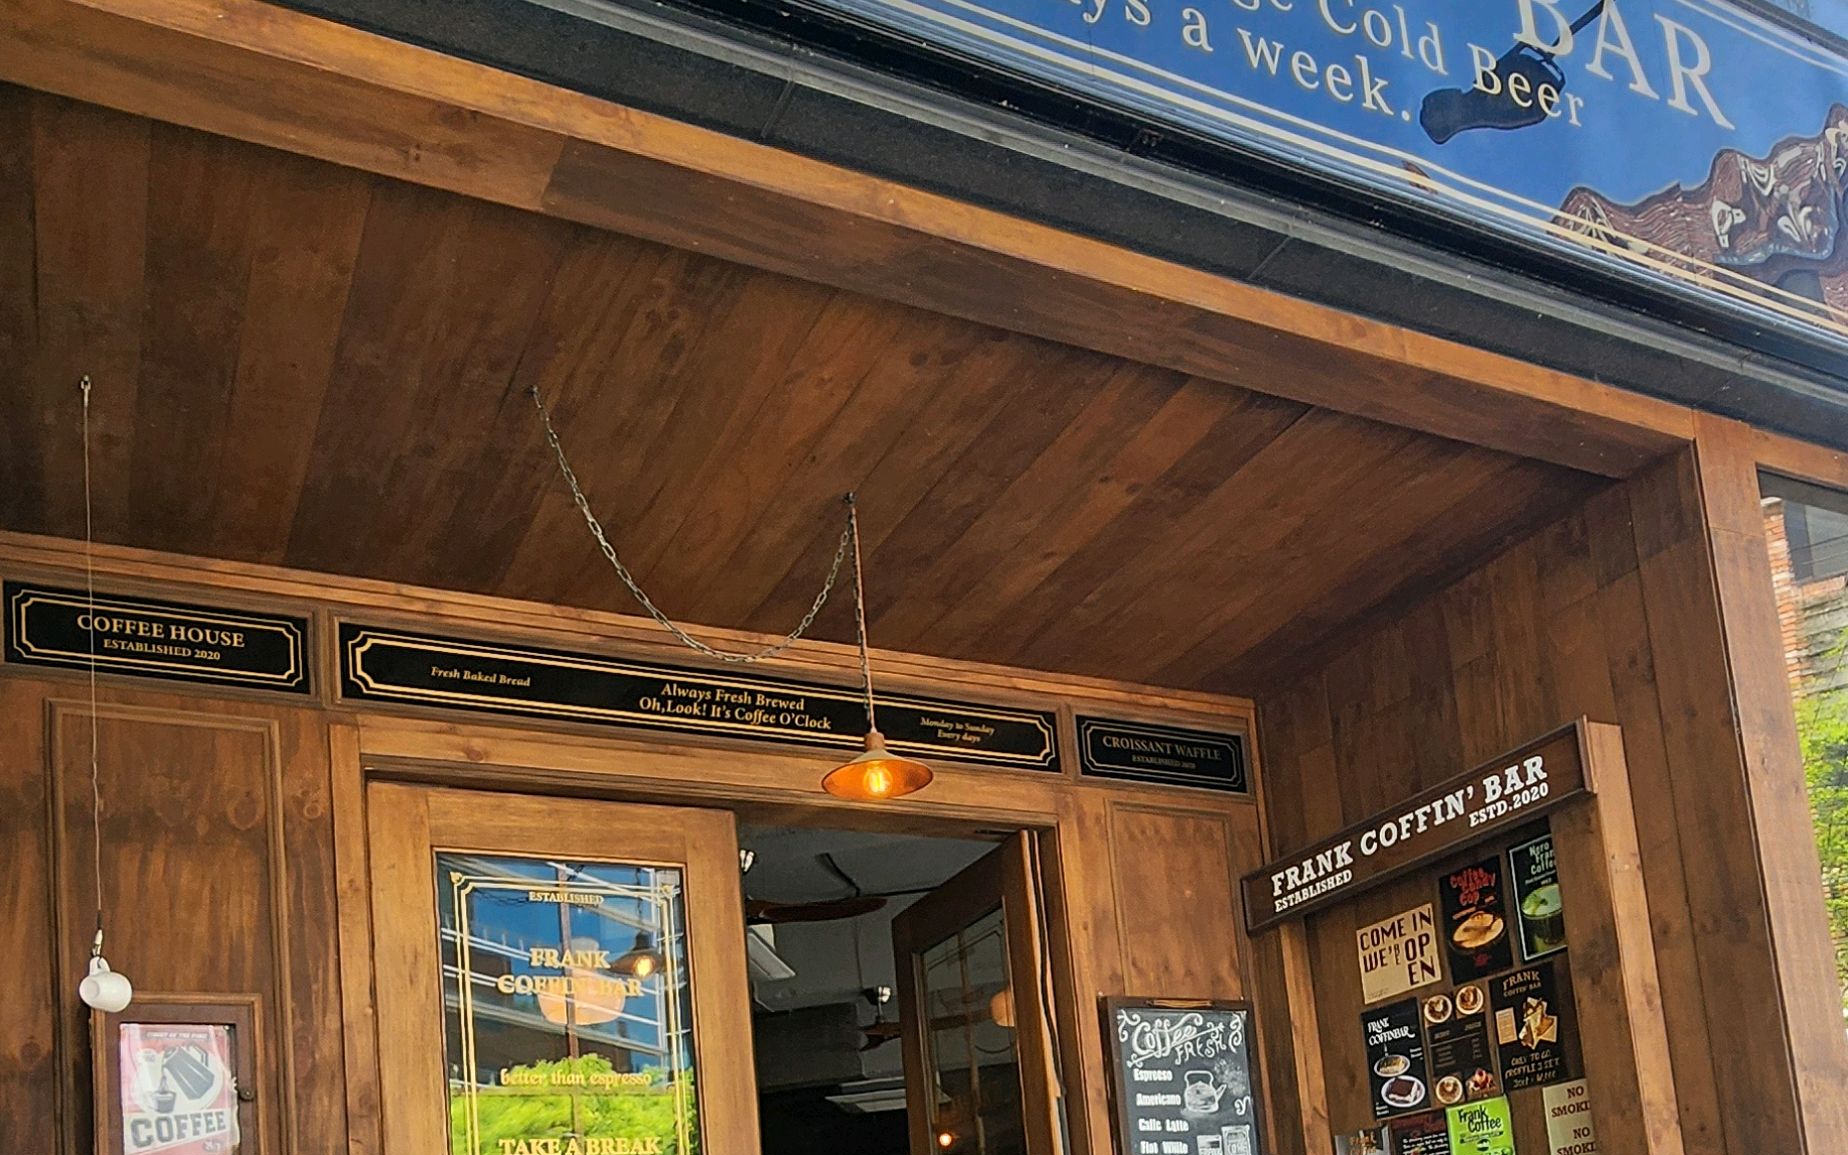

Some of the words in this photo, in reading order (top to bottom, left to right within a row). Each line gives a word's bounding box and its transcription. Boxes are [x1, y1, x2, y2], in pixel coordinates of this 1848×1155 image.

[1182, 8, 1213, 52] a
[1236, 27, 1411, 121] week.
[1319, 0, 1449, 76] Cold
[1466, 42, 1584, 127] Beer
[77, 614, 164, 639] COFFEE
[170, 625, 245, 648] HOUSE
[103, 639, 191, 658] ESTABLISHED
[194, 649, 221, 660] 2020
[431, 666, 460, 679] Fresh
[463, 670, 496, 683] Baked
[499, 674, 530, 687] Bread
[661, 683, 711, 704] Always
[715, 689, 751, 705] Fresh
[756, 694, 804, 710] Brewed
[710, 704, 731, 719] It's
[734, 707, 776, 726] Coffee
[779, 713, 831, 730] O'Clock
[920, 717, 953, 731] Monday
[964, 723, 995, 736] Sunday
[937, 729, 960, 741] Every
[962, 732, 981, 743] days
[1102, 735, 1172, 755] CROISSANT
[1174, 744, 1222, 760] WAFFLE
[1270, 840, 1355, 897] FRANK
[1482, 755, 1548, 804] BAR
[528, 891, 604, 906] ESTABLISHED
[1274, 869, 1353, 912] ESTABLISHED
[1360, 918, 1406, 951] COME
[1412, 907, 1432, 932] IN
[530, 947, 611, 969] FRANK
[1503, 970, 1540, 990] FRANK
[1131, 1013, 1203, 1058] Coffee
[500, 1068, 547, 1086] better
[552, 1070, 584, 1085] than
[590, 1073, 652, 1089] espresso
[1567, 1086, 1584, 1099] NO
[1458, 1105, 1488, 1123] Frank
[130, 1110, 226, 1149] COFFEE
[1468, 1117, 1502, 1133] Coffee
[1573, 1126, 1590, 1139] NO
[586, 1137, 663, 1155] BREAK
